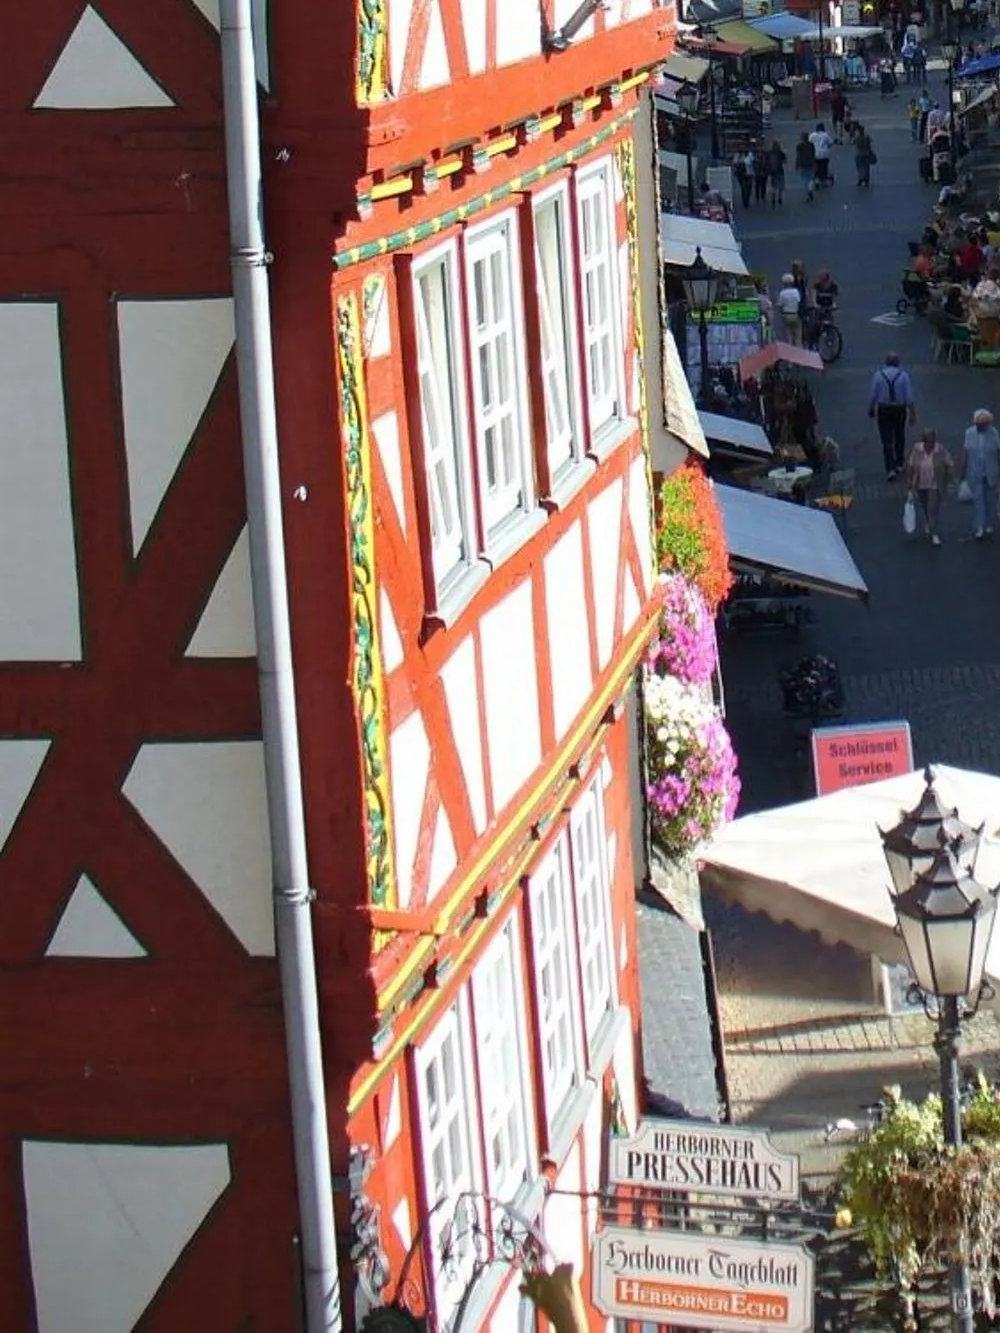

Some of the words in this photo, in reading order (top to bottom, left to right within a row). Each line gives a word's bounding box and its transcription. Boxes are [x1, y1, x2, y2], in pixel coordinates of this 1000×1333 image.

[829, 738, 898, 758] Schlüssel
[838, 762, 894, 778] Service
[654, 1132, 755, 1160] HERBORNER
[627, 1152, 782, 1192] PRESSEHAUS
[604, 1240, 702, 1277] Herborner
[708, 1248, 798, 1289] Tageblatt
